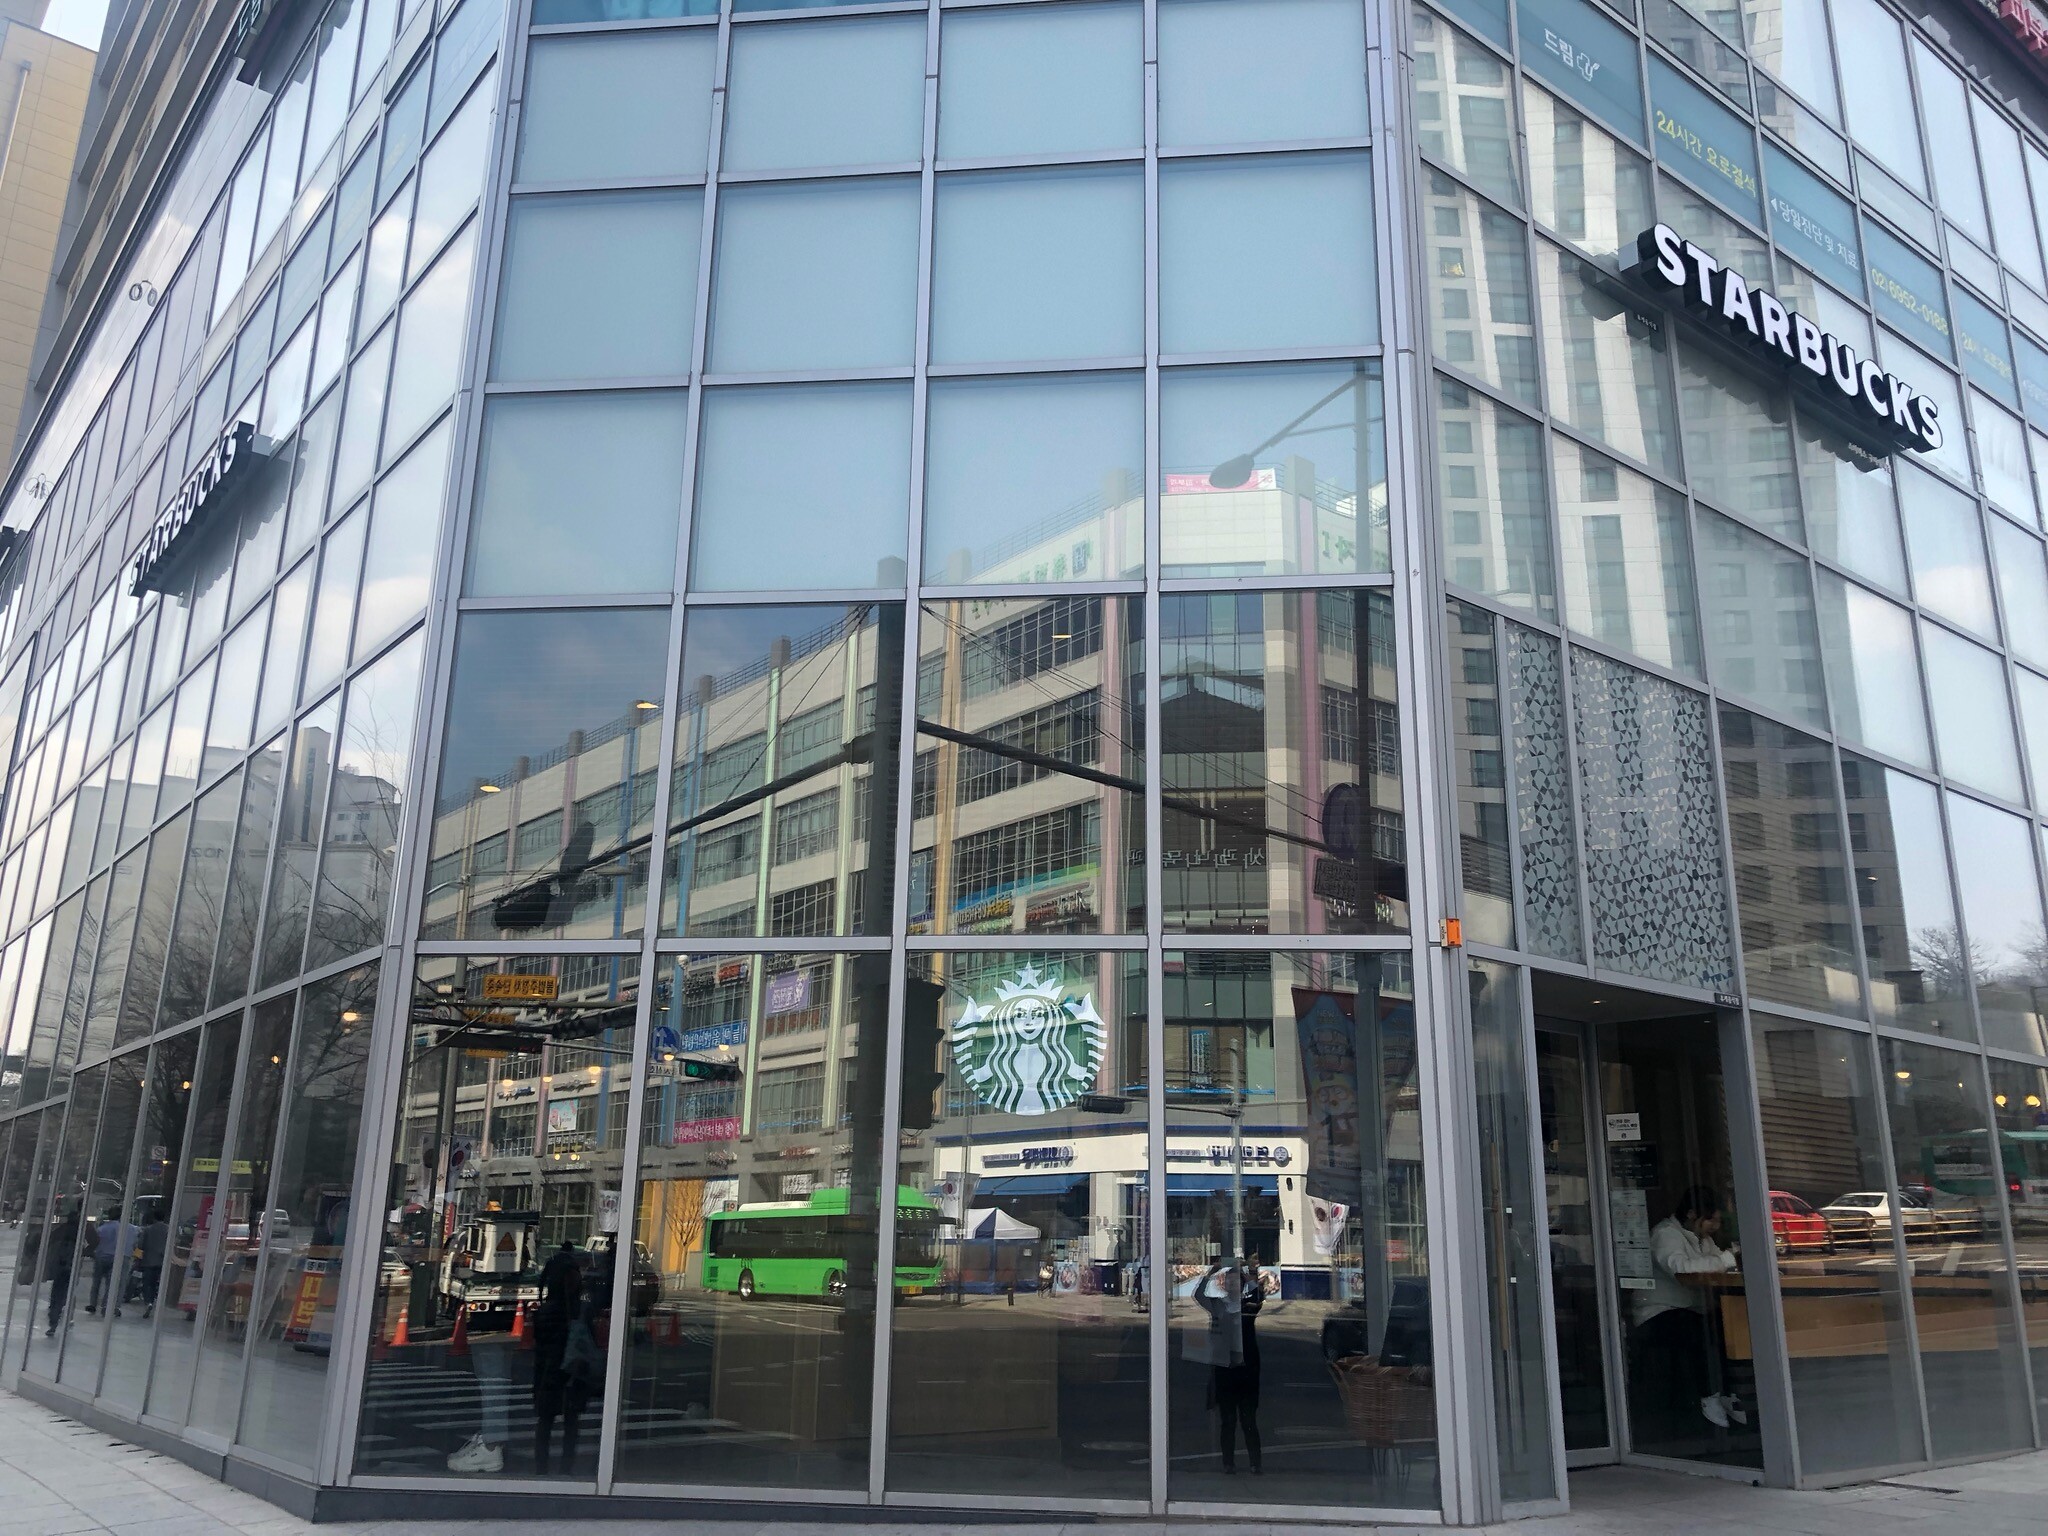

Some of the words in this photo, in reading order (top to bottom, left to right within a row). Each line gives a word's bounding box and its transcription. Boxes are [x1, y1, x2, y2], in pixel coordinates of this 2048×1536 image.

[1544, 28, 1574, 68] 드림
[1656, 110, 1702, 159] 24시간
[1706, 147, 1756, 198] 요로결석
[1779, 200, 1823, 246] 당일진단
[1824, 234, 1835, 256] 및
[1837, 242, 1859, 270] 치료
[1654, 222, 1943, 449] STARBUCKS
[128, 420, 240, 597] STARBUCKS
